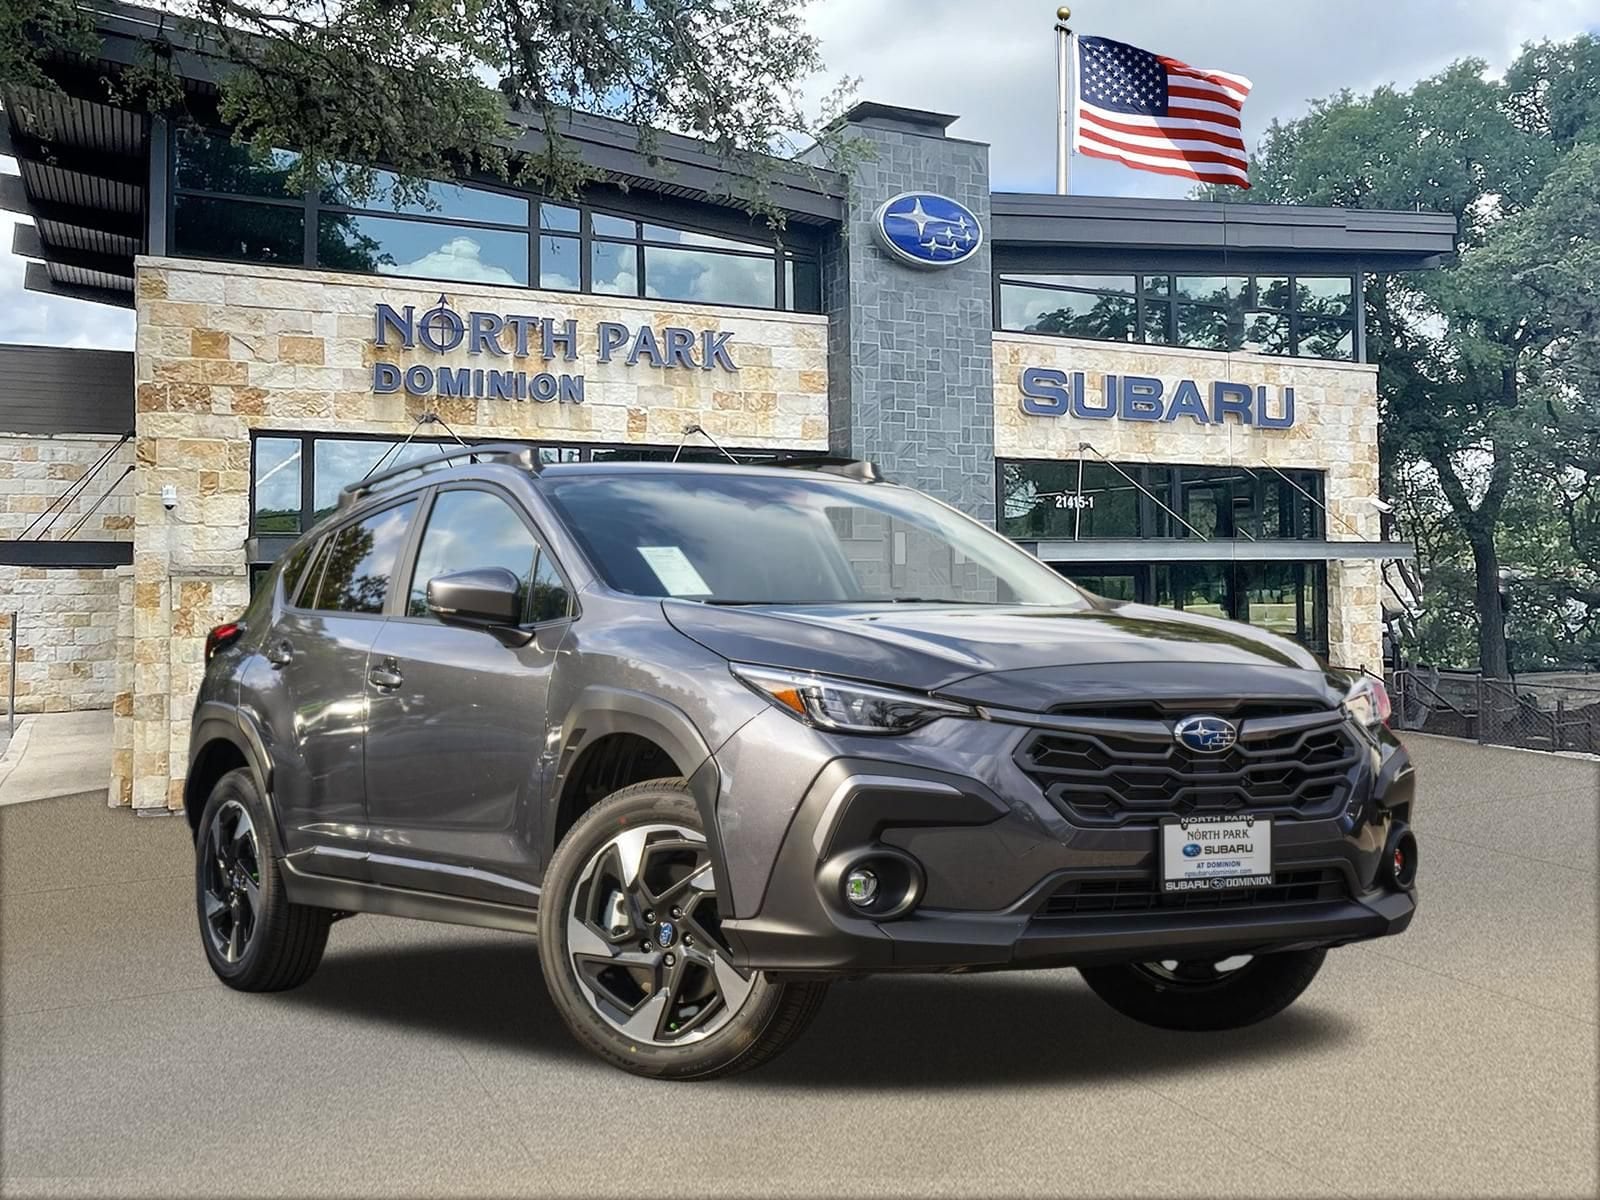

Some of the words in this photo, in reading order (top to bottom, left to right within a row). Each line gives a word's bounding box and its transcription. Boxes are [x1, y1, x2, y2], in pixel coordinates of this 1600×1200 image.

[374, 299, 580, 361] NORTH
[597, 320, 741, 373] PARK
[373, 362, 585, 403] DOMINION
[1019, 367, 1296, 430] SUBARU
[1181, 816, 1220, 824] NORTH
[1187, 829, 1220, 840] NORTH
[1223, 829, 1249, 840] PARK
[1204, 844, 1253, 855] SUBARU
[1165, 880, 1209, 890] SUBARU
[1226, 876, 1272, 887] DOMINION
